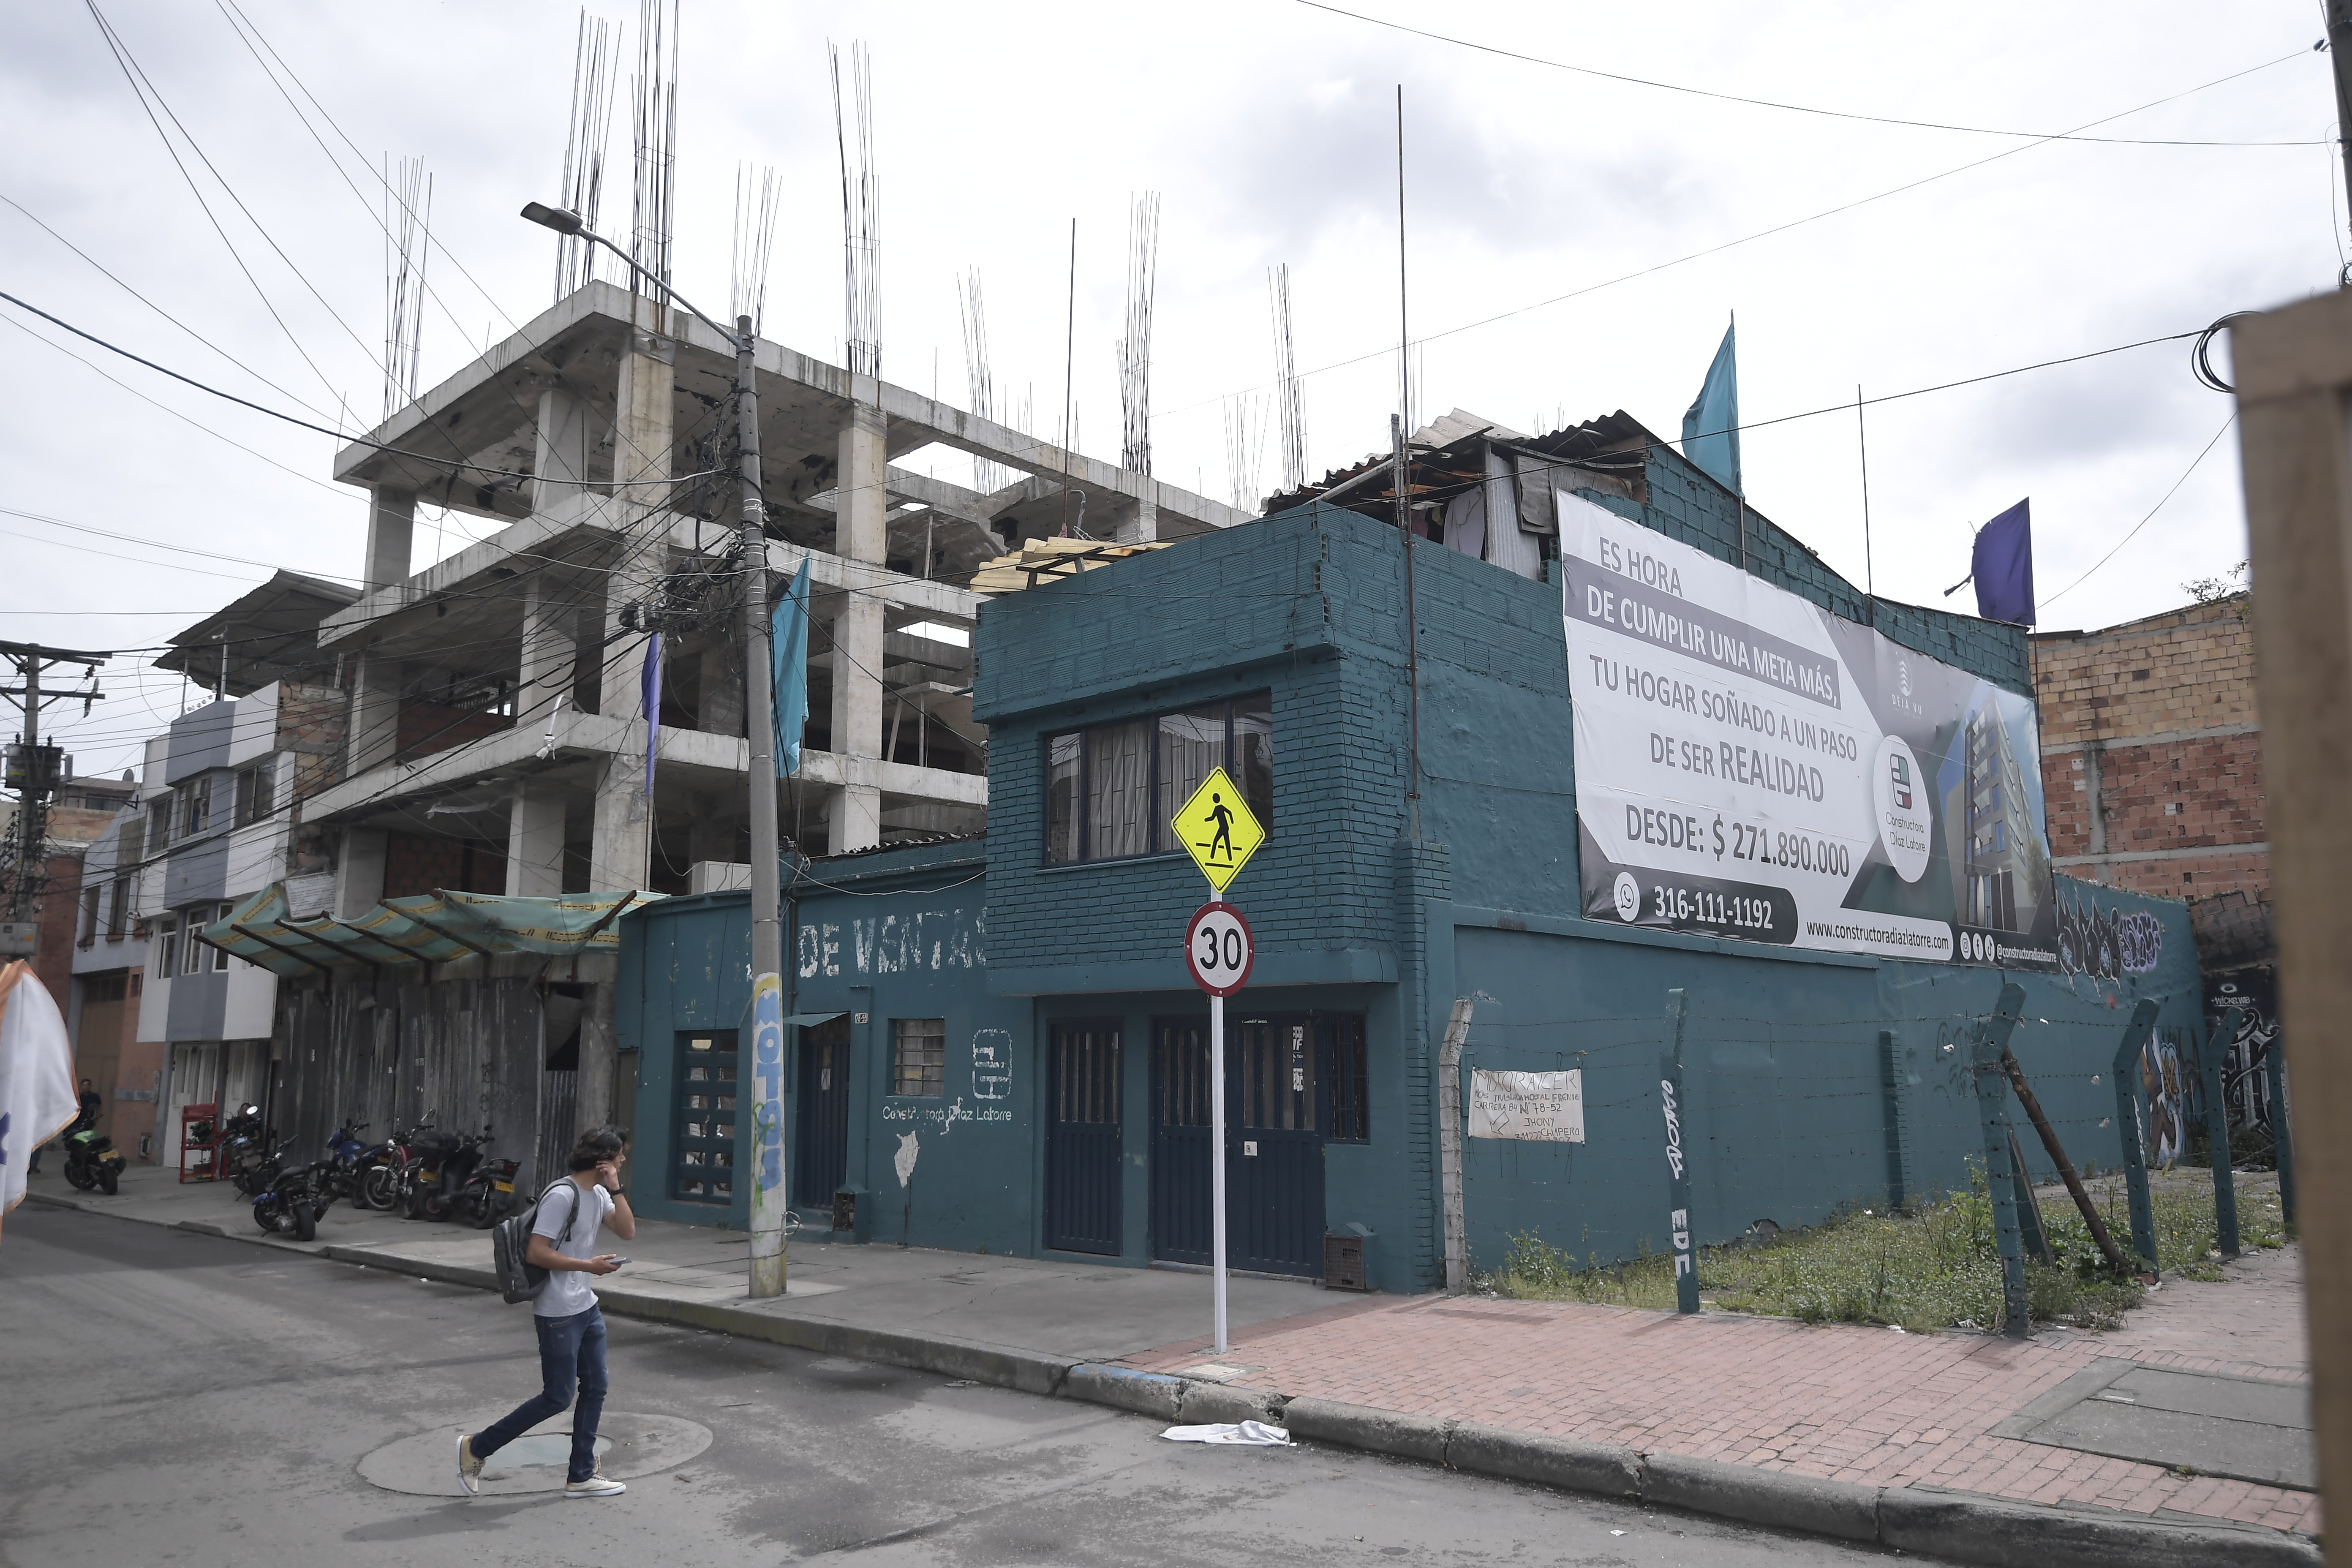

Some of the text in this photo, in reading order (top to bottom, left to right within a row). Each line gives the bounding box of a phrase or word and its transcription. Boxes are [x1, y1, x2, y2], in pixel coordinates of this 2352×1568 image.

[1599, 536, 1683, 597] ES HORA
[1587, 584, 1838, 707] DE CUMPLIR UNA META MÁS,
[1589, 655, 1857, 761] TU HOGAR SOÑADO A UN PASO
[1913, 702, 1922, 714] VU
[1650, 733, 1824, 803] DE SER REALIDAD
[1886, 812, 1924, 833] Constructora
[1626, 804, 1850, 877] DESDE: $ 271.890.000
[1890, 831, 1925, 852] Díaz Latorre
[1654, 886, 1773, 930] 316-111-1192
[1806, 921, 1949, 950] www.constructoradiazlatorre.com
[1199, 927, 1241, 971] 30
[1997, 944, 2057, 963] @constructoradiazlatorre
[1474, 1101, 1506, 1111] CARRERA
[1508, 1103, 1518, 1111] 84
[1533, 1103, 1562, 1115] 78-52
[1475, 1089, 1489, 1098] NOS
[1552, 1093, 1579, 1102] FRENTE
[977, 1106, 1012, 1121] Latorre
[1523, 1117, 1554, 1127] JHONY
